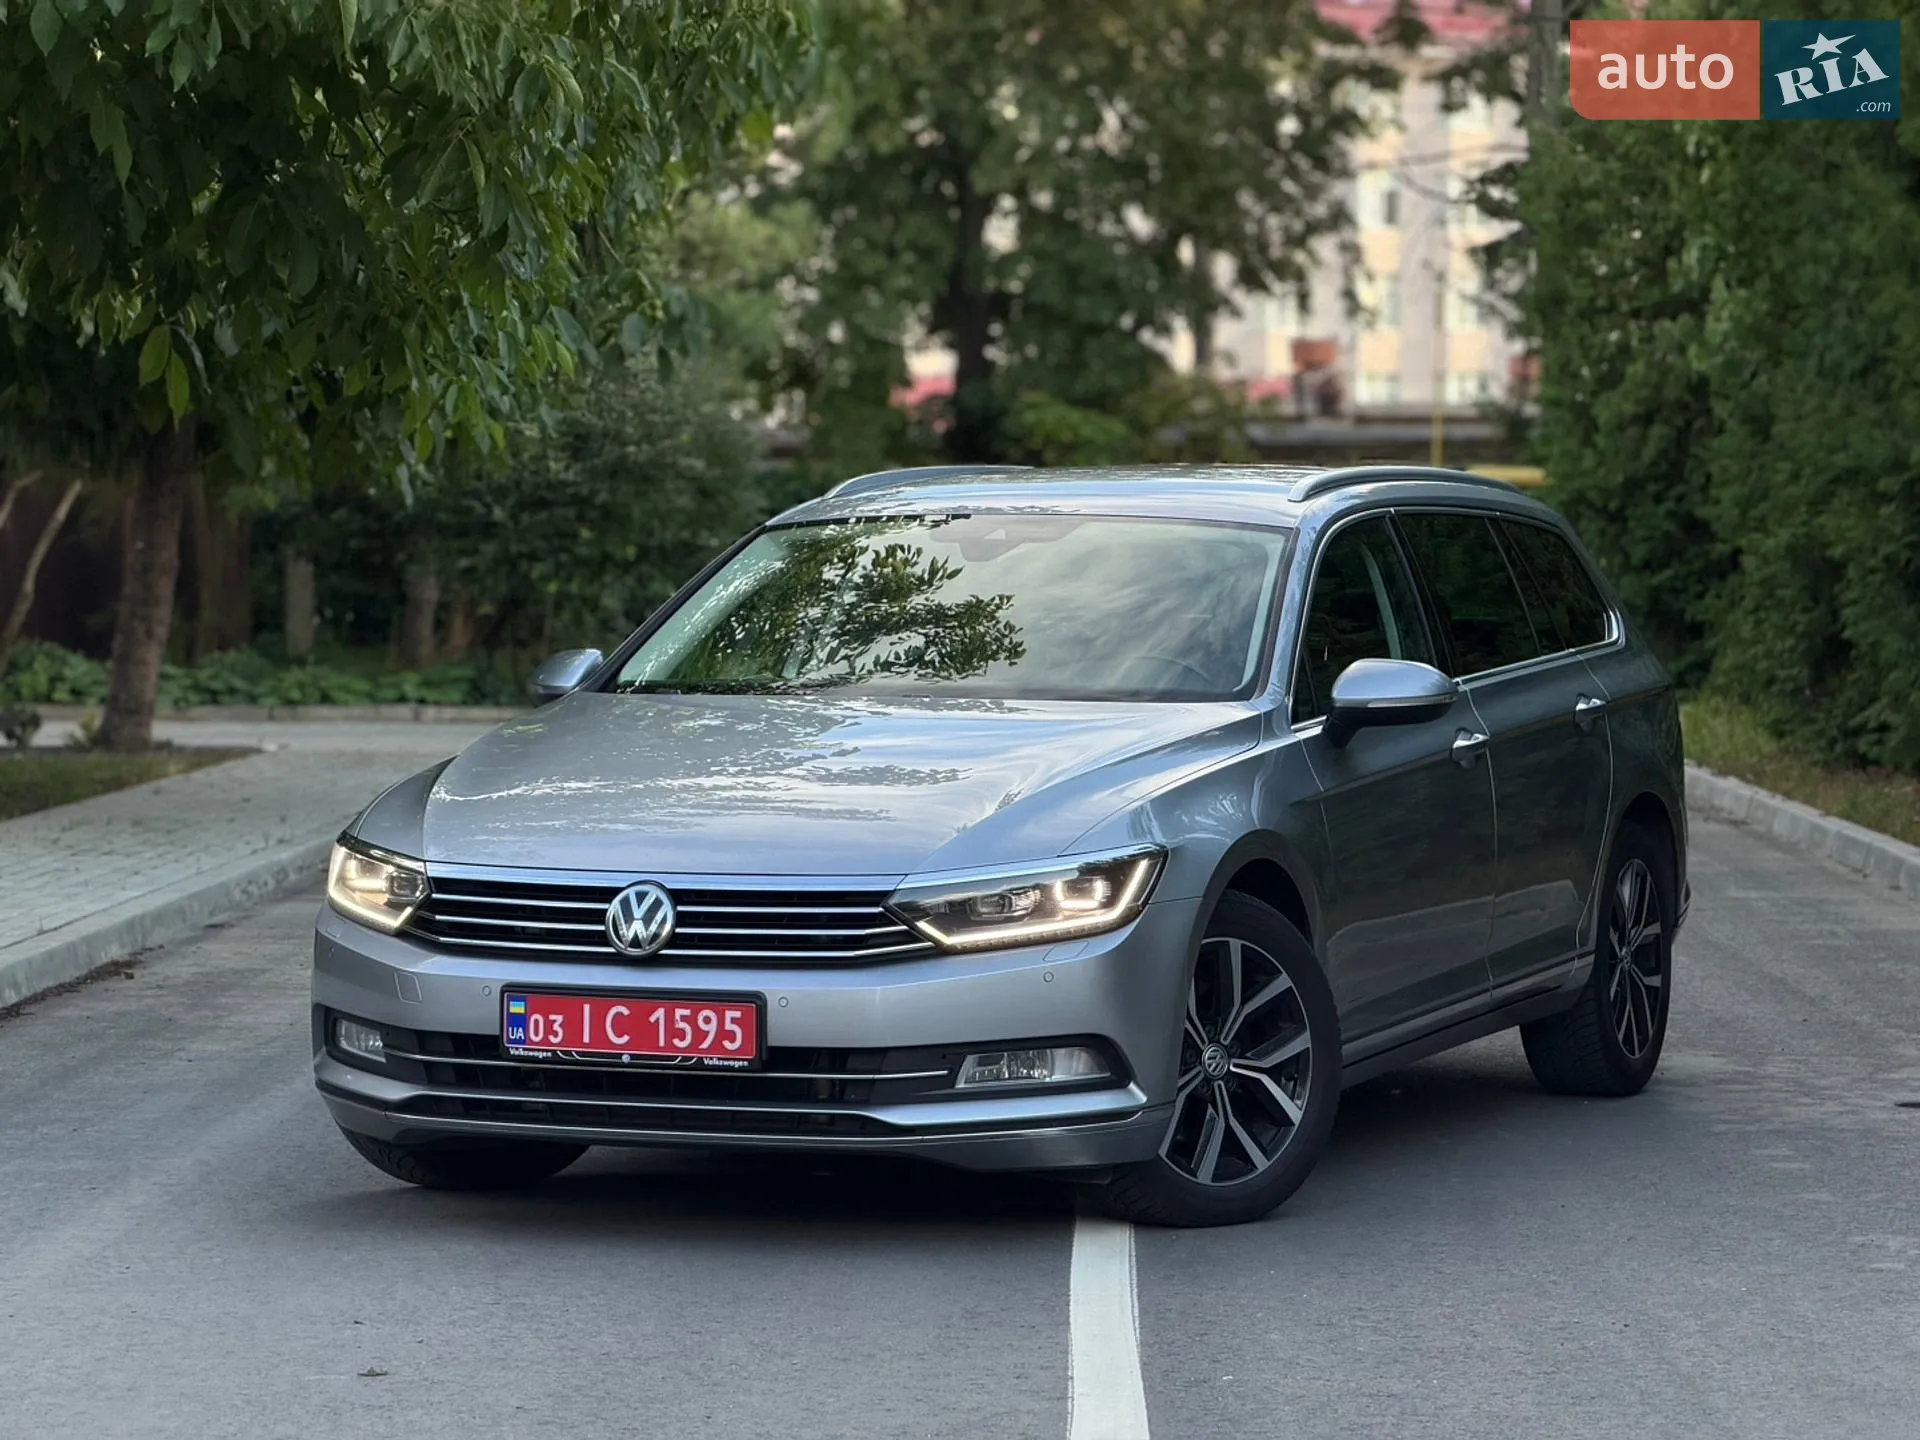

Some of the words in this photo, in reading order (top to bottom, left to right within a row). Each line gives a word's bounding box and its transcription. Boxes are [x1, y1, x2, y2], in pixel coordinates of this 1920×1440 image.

[509, 1027, 525, 1040] UA
[529, 1013, 564, 1044] 03
[648, 1008, 743, 1051] 1595
[509, 1048, 552, 1059] Volkswagen
[703, 1057, 749, 1067] Volkswagen
